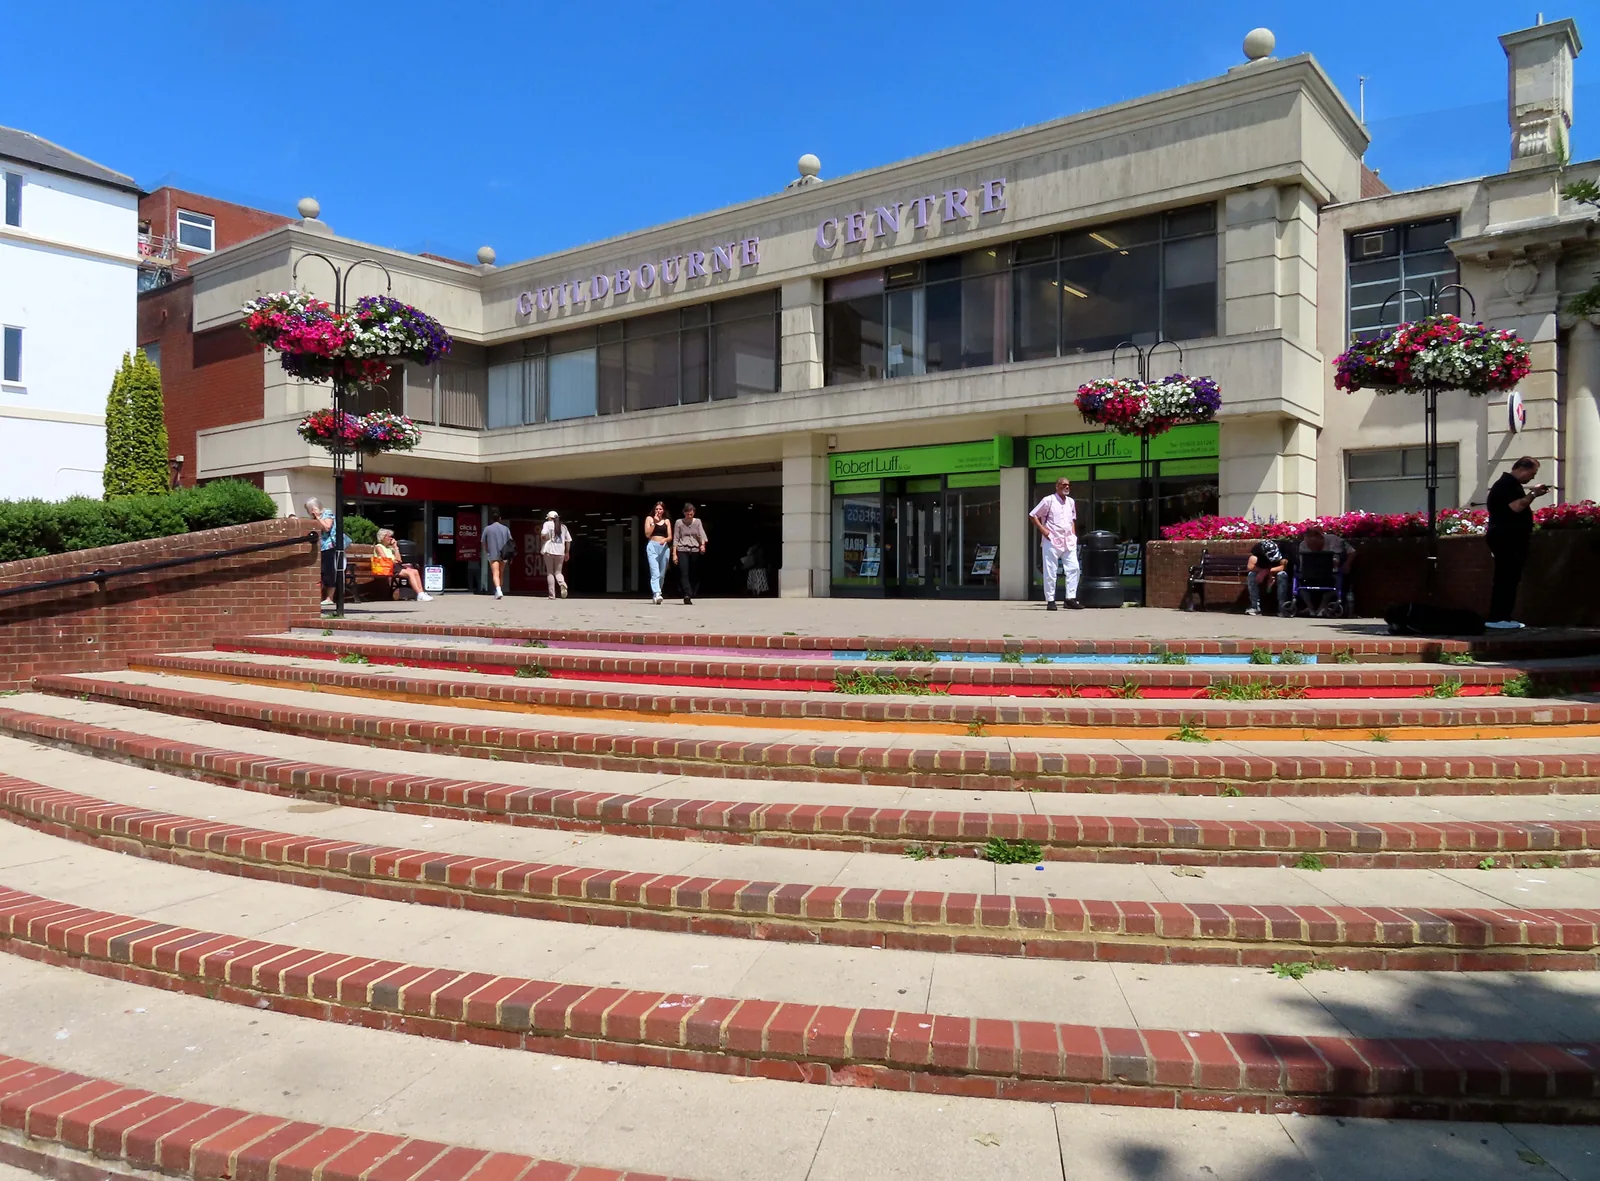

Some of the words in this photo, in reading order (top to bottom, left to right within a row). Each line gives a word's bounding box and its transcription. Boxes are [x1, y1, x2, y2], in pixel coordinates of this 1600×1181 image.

[516, 235, 761, 317] GUILDBOURNE
[815, 177, 1009, 250] CENTRE
[1035, 442, 1084, 460] Robert
[1087, 438, 1116, 457] Luff
[835, 458, 873, 475] Robert
[876, 455, 899, 472] Luff
[364, 477, 408, 497] wilko
[524, 534, 541, 553] BI
[525, 554, 548, 576] SAL
